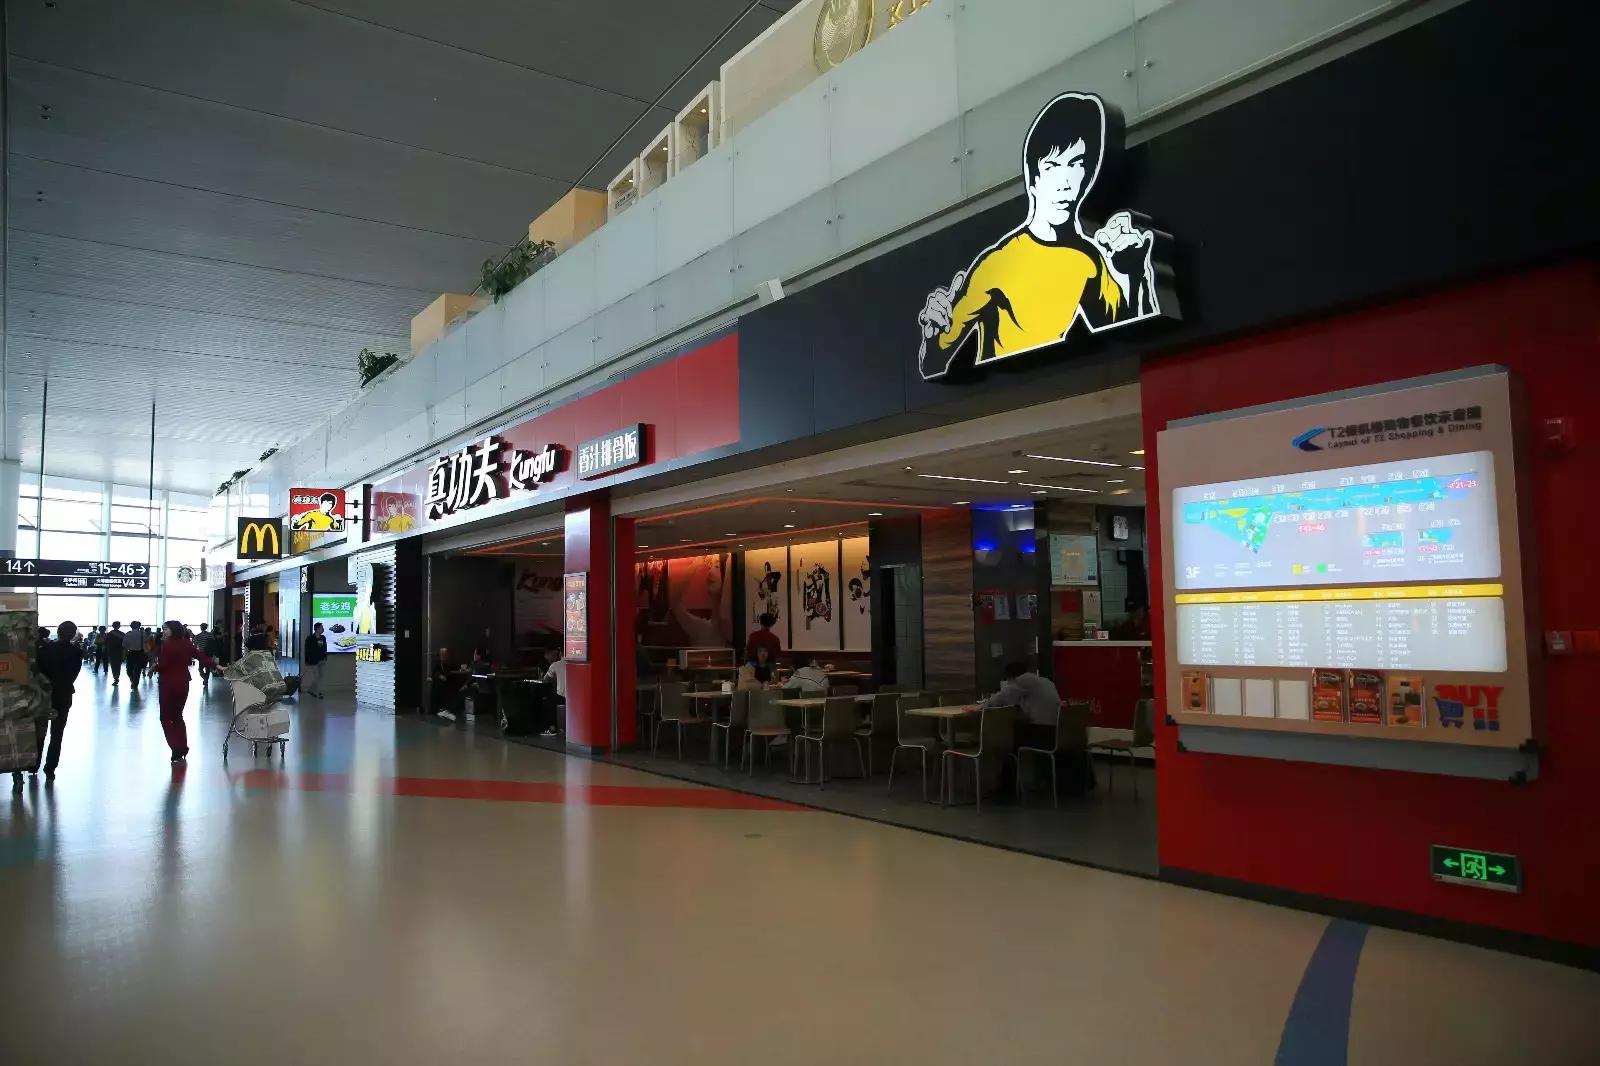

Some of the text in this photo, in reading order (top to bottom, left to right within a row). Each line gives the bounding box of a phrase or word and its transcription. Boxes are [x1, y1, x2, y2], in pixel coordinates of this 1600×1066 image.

[1361, 437, 1371, 445] of
[1388, 428, 1434, 441] Shopping
[1448, 422, 1482, 433] Dining
[579, 430, 637, 474] 香汁排骨饭
[509, 444, 556, 490] Kungfu
[424, 437, 500, 517] 真功夫
[6, 560, 22, 573] 14
[98, 562, 135, 576] 15-46
[1185, 566, 1201, 579] 3F
[122, 579, 136, 588] V4
[320, 602, 350, 611] 老乡鸡
